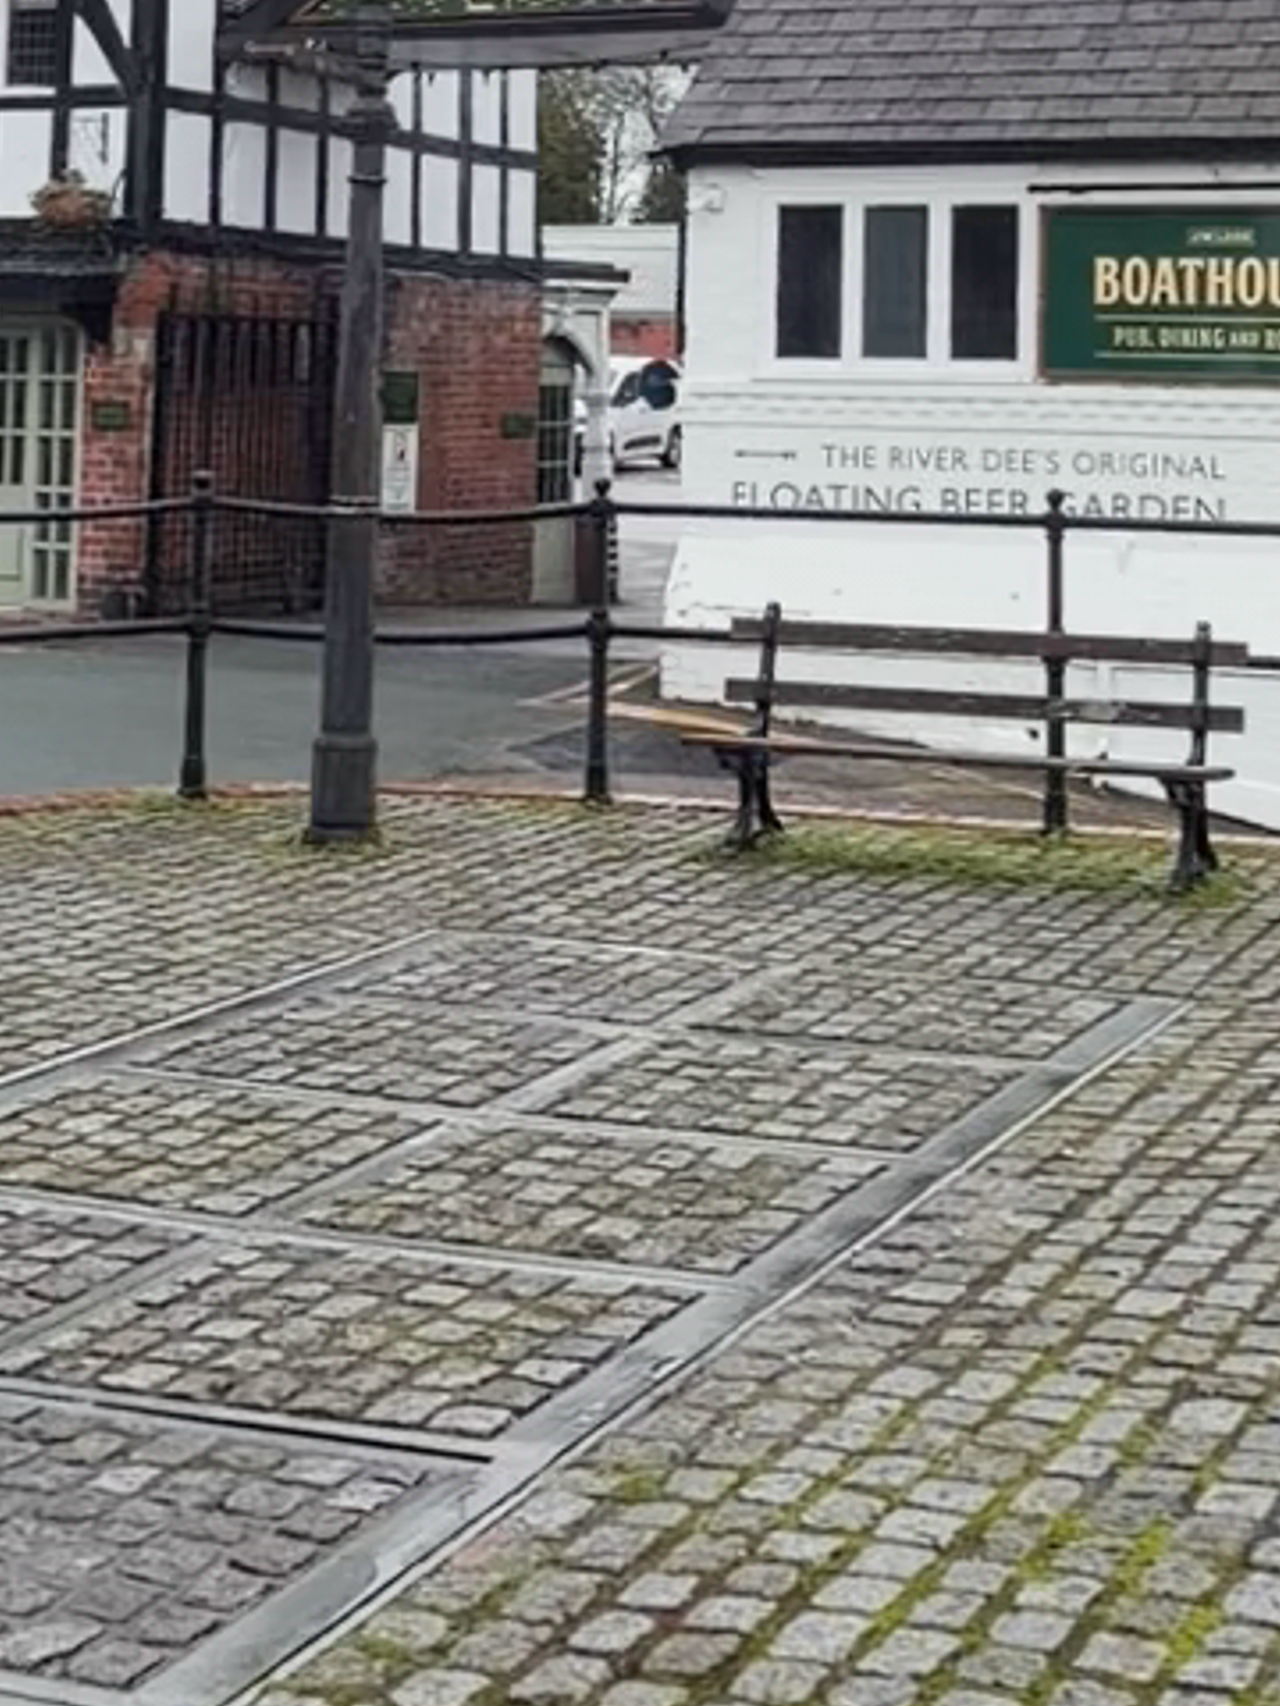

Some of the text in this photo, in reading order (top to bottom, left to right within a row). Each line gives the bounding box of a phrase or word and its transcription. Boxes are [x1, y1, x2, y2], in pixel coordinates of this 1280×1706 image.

[1158, 326, 1223, 350] DINING
[1228, 330, 1261, 349] AND
[821, 444, 1227, 480] THE RIVER DEE'S ORIGINAL
